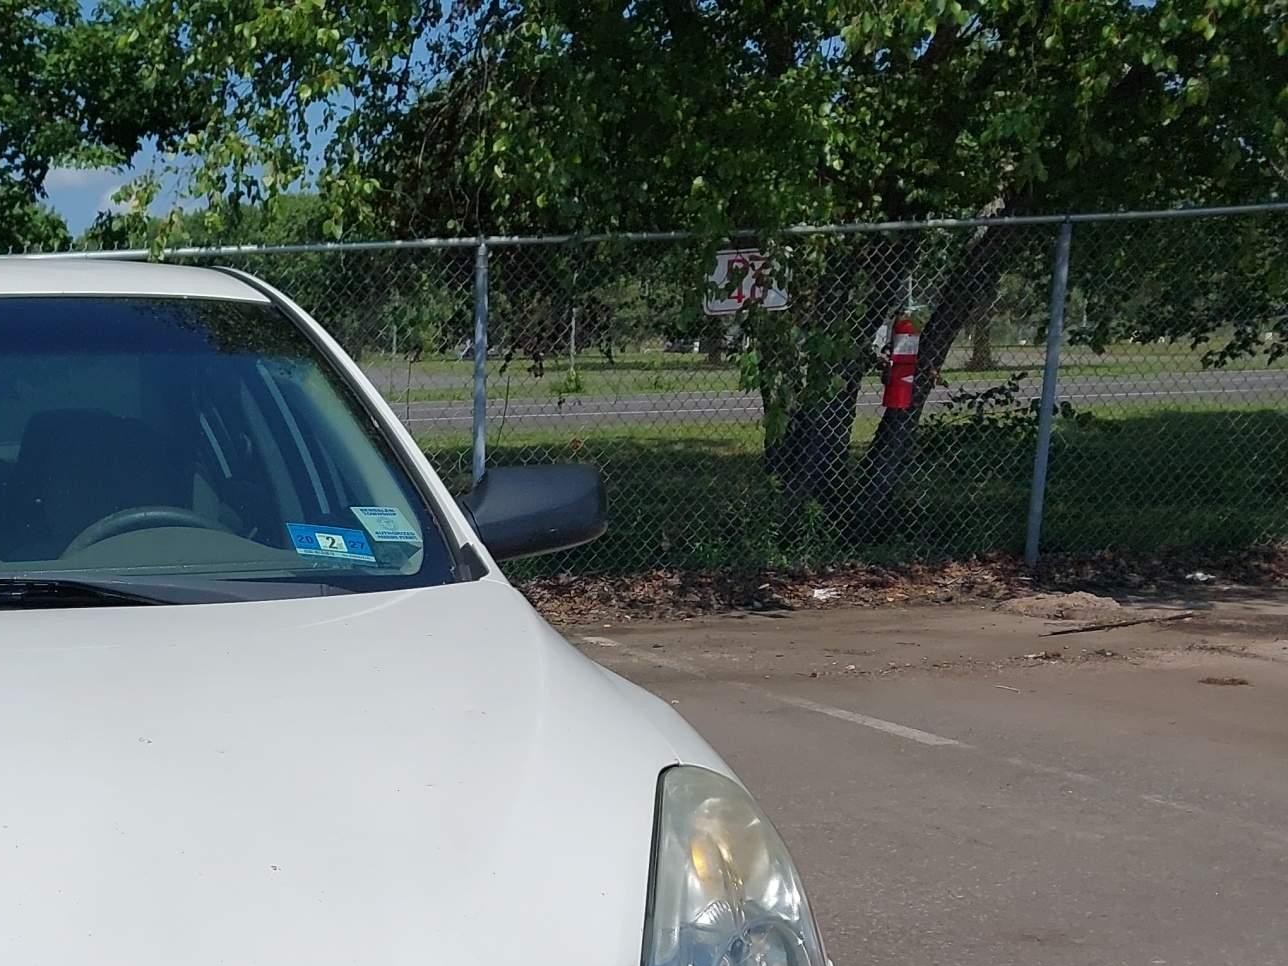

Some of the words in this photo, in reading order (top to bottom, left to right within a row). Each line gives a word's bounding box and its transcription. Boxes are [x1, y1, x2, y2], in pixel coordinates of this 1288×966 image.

[296, 534, 315, 545] 20
[325, 536, 339, 550] 2
[348, 540, 365, 550] 27
